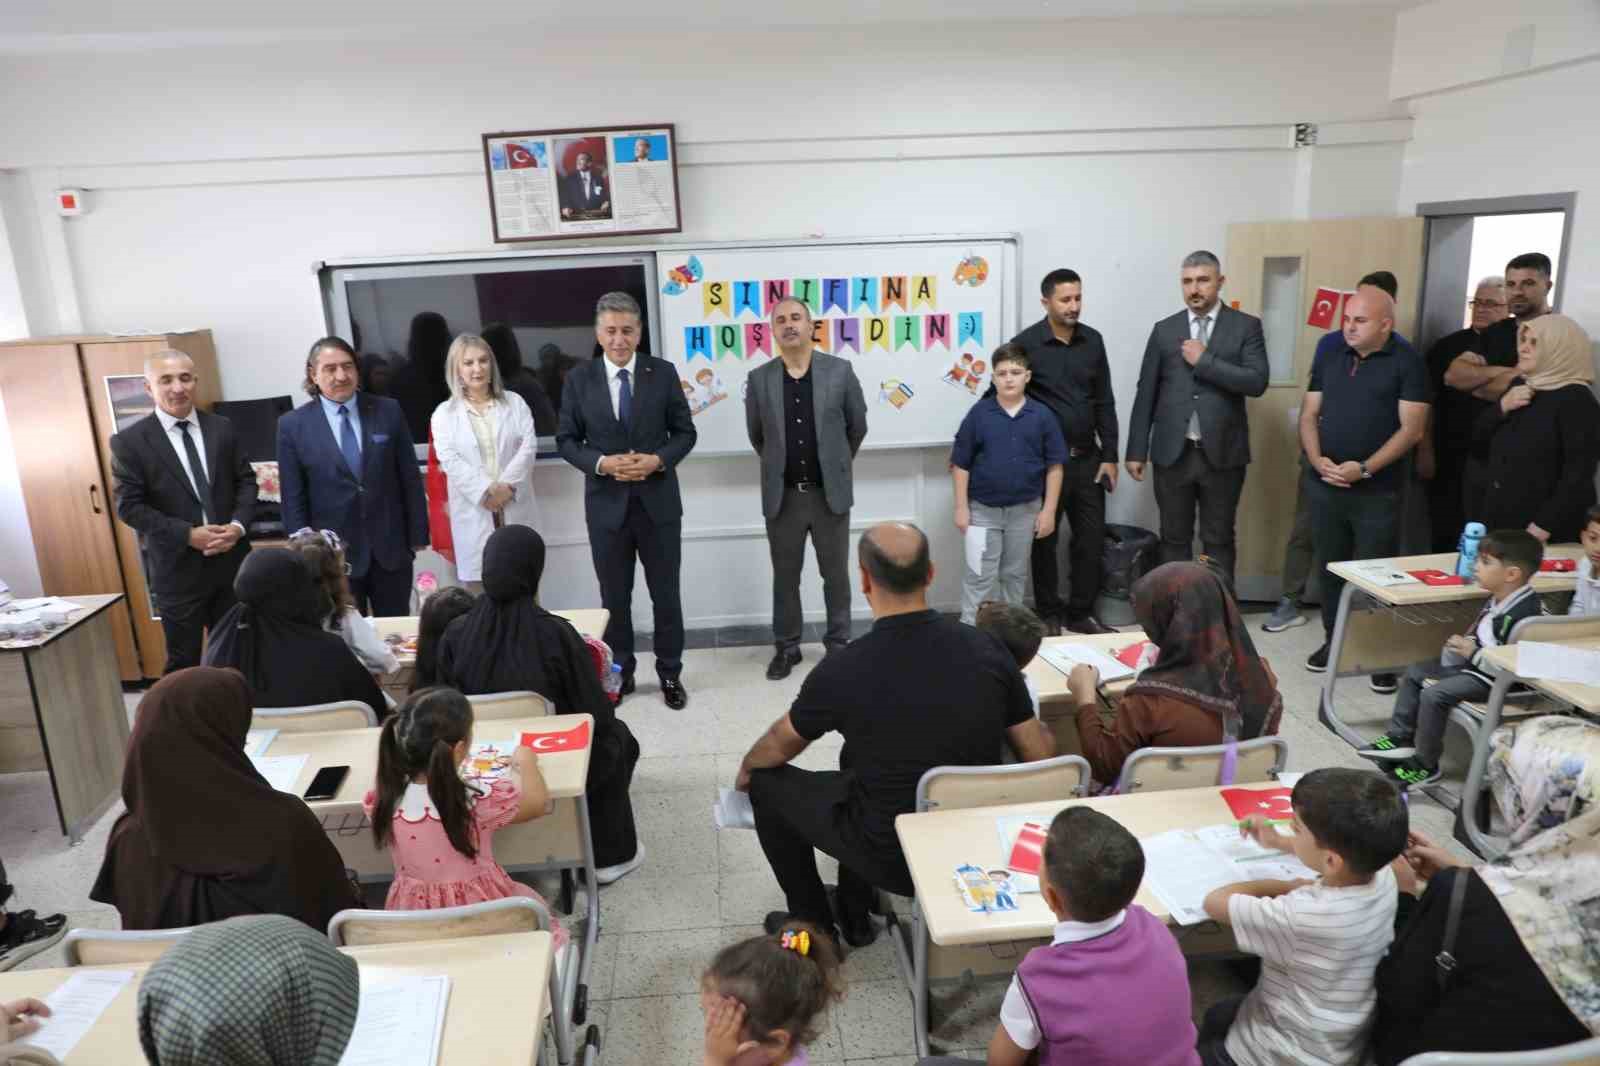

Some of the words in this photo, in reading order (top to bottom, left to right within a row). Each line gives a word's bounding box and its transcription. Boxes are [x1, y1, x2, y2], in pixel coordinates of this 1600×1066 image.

[709, 277, 931, 305] SINIFINA
[691, 323, 763, 349] HOŞ
[811, 313, 946, 342] ELDİN
